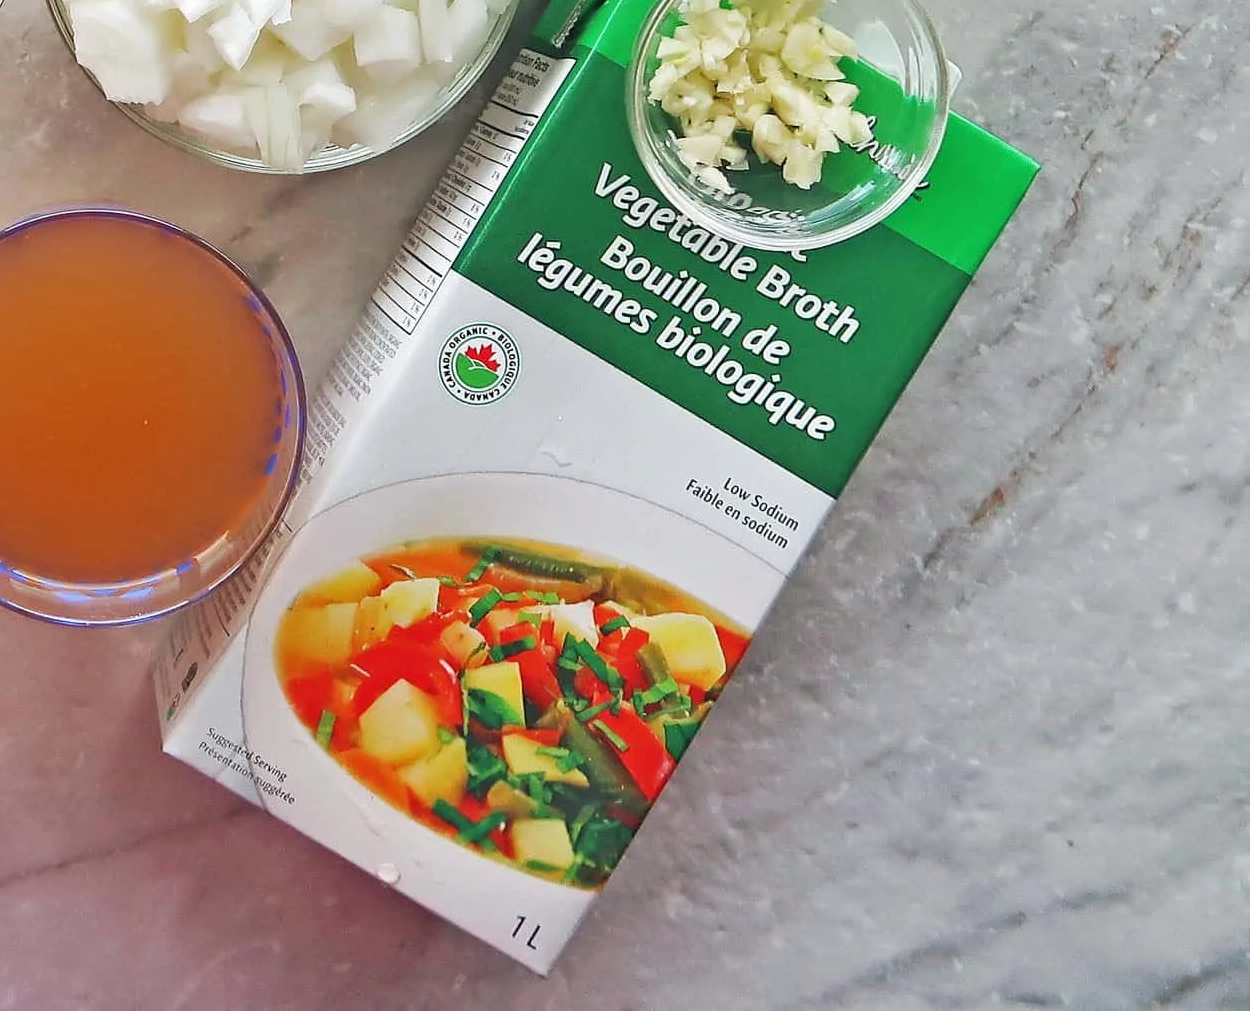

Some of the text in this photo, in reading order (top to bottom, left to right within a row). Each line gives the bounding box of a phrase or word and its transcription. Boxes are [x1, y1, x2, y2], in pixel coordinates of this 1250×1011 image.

[594, 162, 758, 280] Vegetable
[756, 264, 861, 344] Broth
[600, 235, 791, 365] Bouillon de
[442, 327, 488, 388] CANADA ORGANIC
[464, 334, 517, 401] BIOLOGIQUE CANADA
[517, 232, 836, 441] légumes biologique
[685, 478, 789, 549] Faible en sodium
[723, 477, 799, 531] Low Sodium
[206, 727, 287, 783] Suggested Serving
[254, 776, 295, 805] suggérée
[512, 916, 541, 950] 1 L
